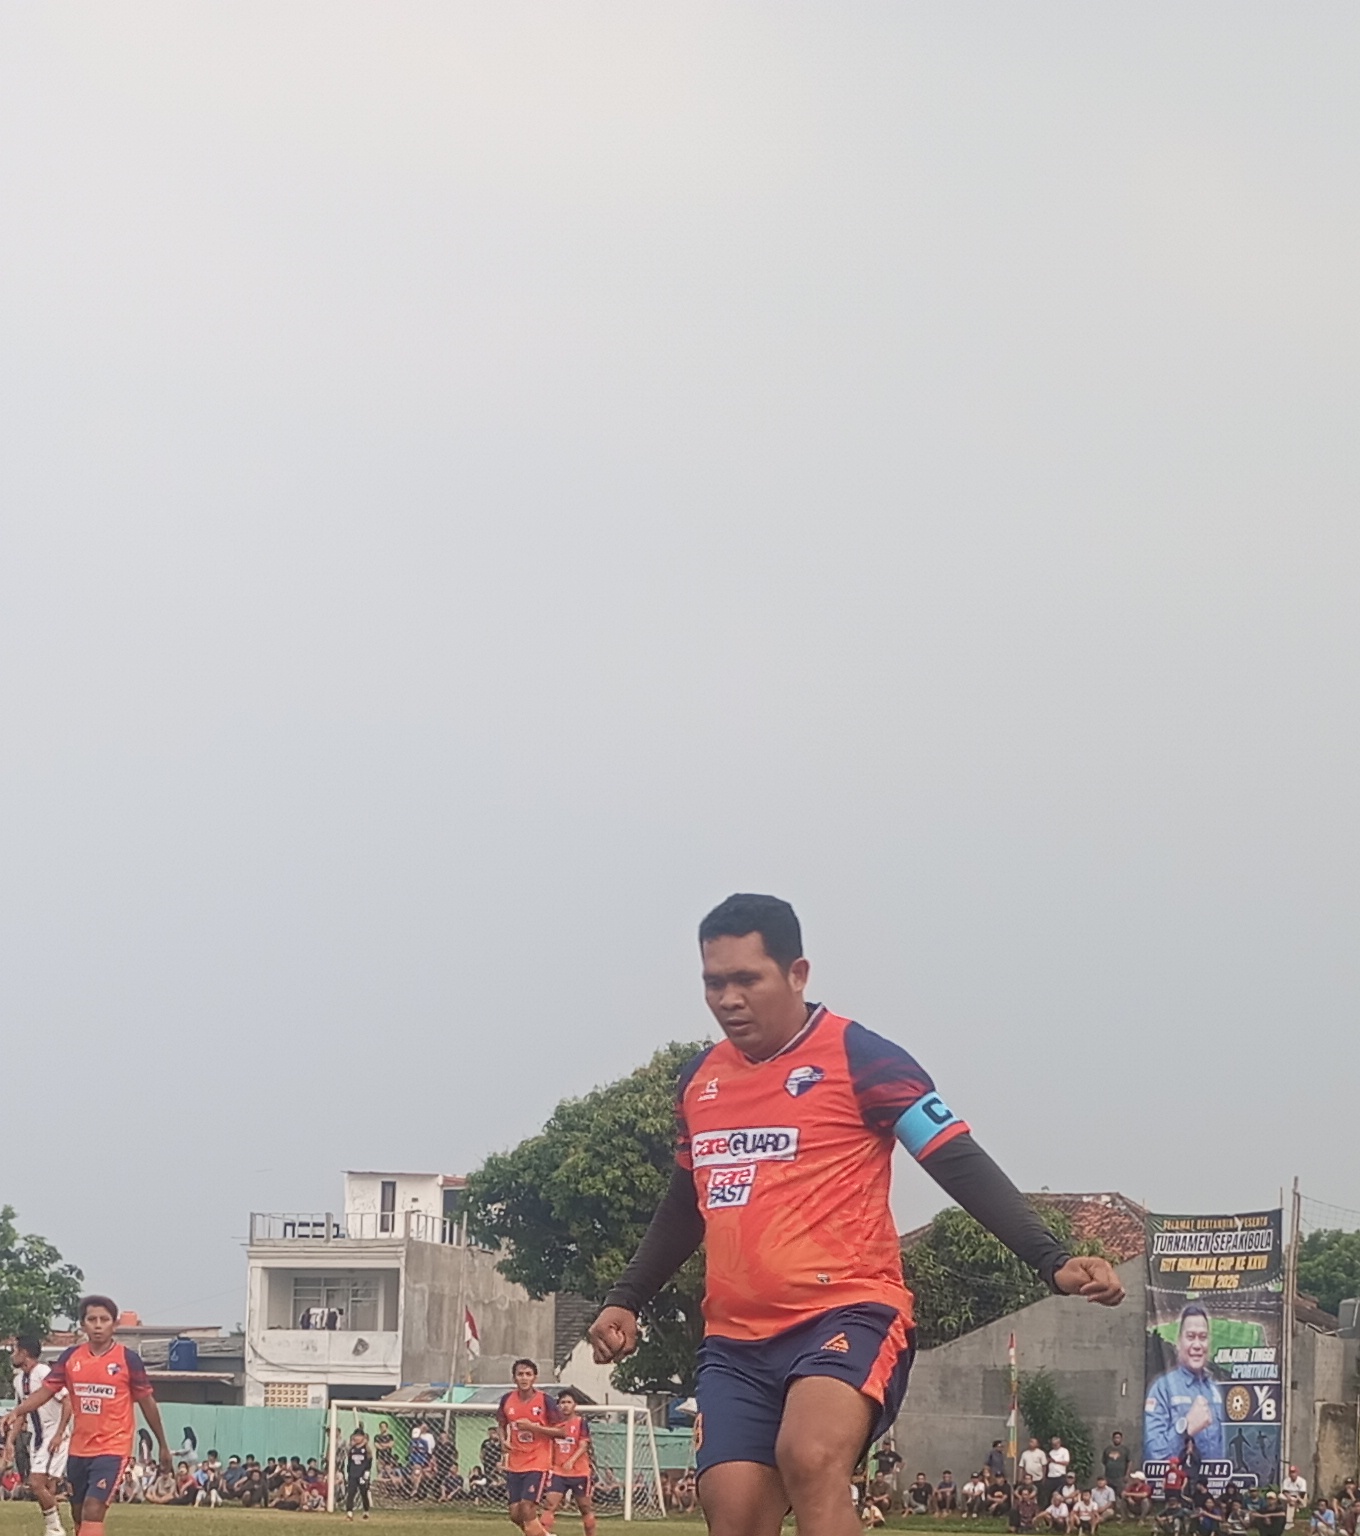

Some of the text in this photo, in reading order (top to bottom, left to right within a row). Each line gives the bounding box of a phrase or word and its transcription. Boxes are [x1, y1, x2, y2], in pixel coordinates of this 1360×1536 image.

[922, 1098, 954, 1125] C
[1154, 1230, 1273, 1254] TURNAMEN SEPAK BOLA
[1218, 1256, 1235, 1271] CUP
[1235, 1256, 1246, 1270] KE
[1188, 1274, 1240, 1289] TAHUN 2026
[1251, 1347, 1277, 1363] TINGGI
[1231, 1364, 1279, 1379] SPORTIVITAS
